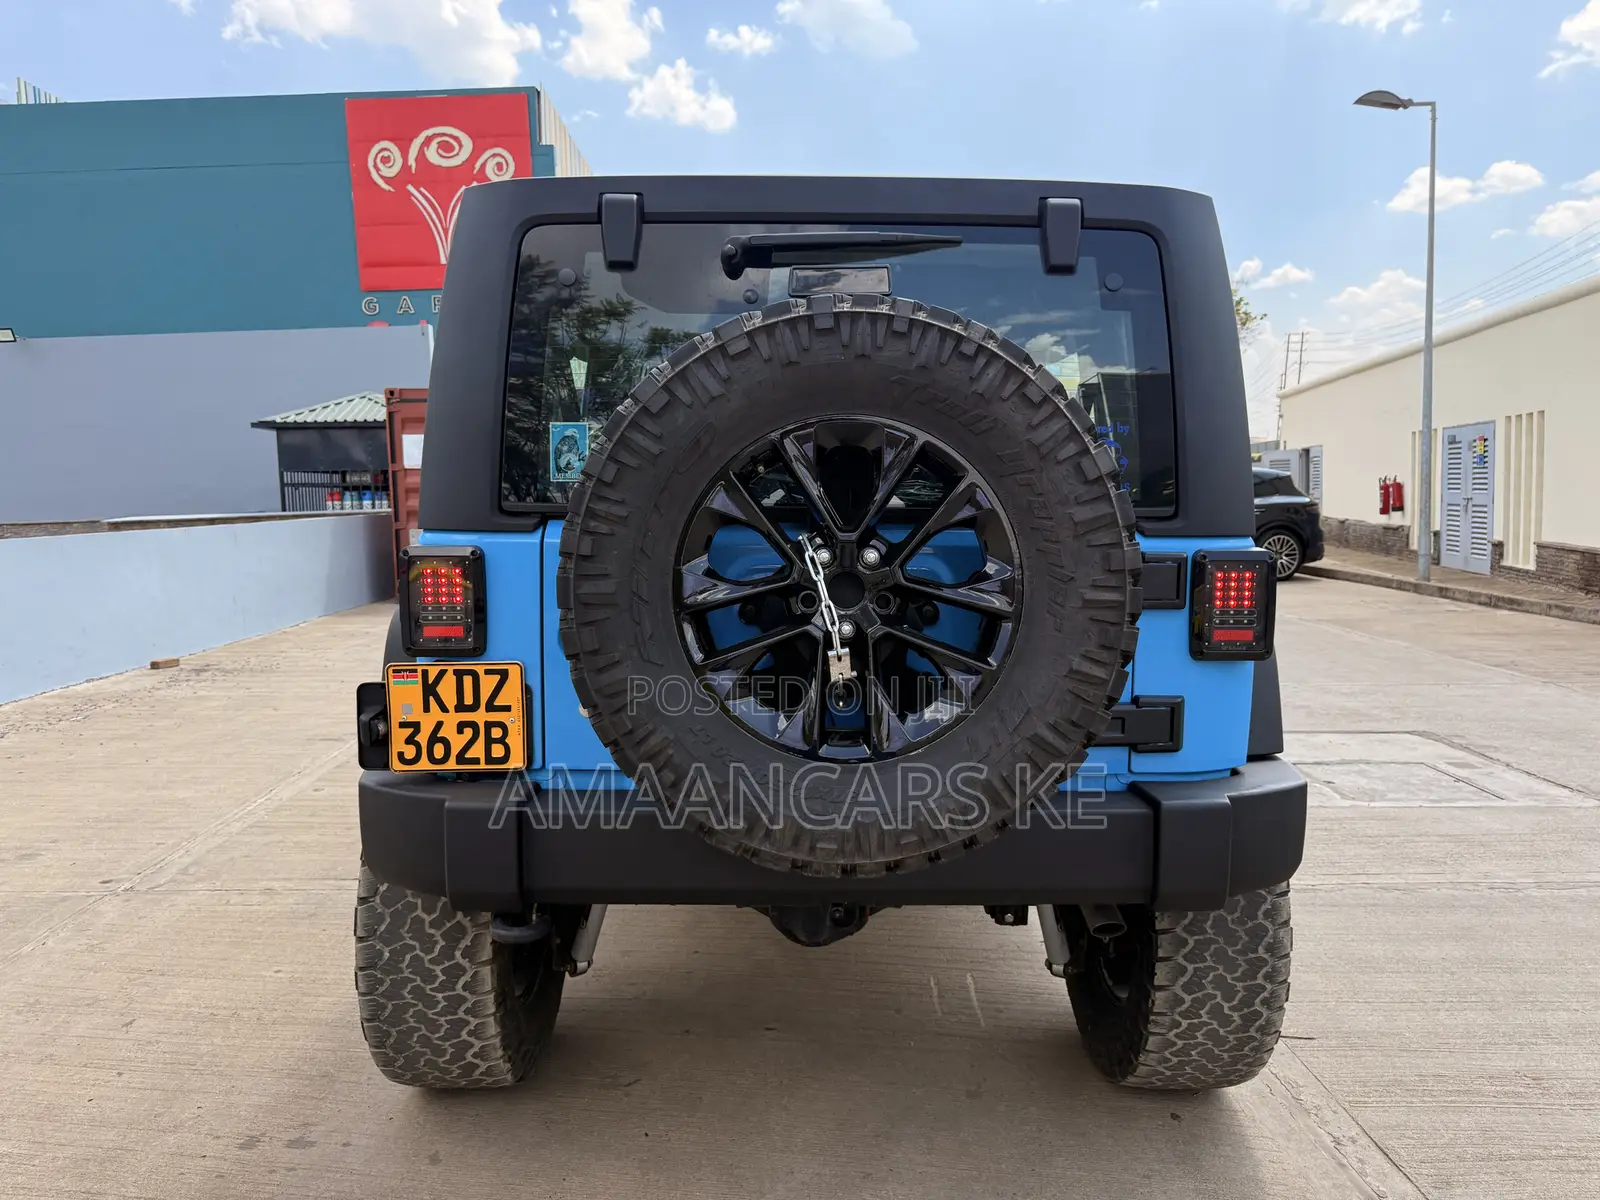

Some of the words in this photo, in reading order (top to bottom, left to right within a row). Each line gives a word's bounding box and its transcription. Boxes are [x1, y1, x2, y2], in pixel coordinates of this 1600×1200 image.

[1117, 422, 1130, 436] by
[420, 668, 512, 714] KDZ
[396, 720, 511, 766] 362B
